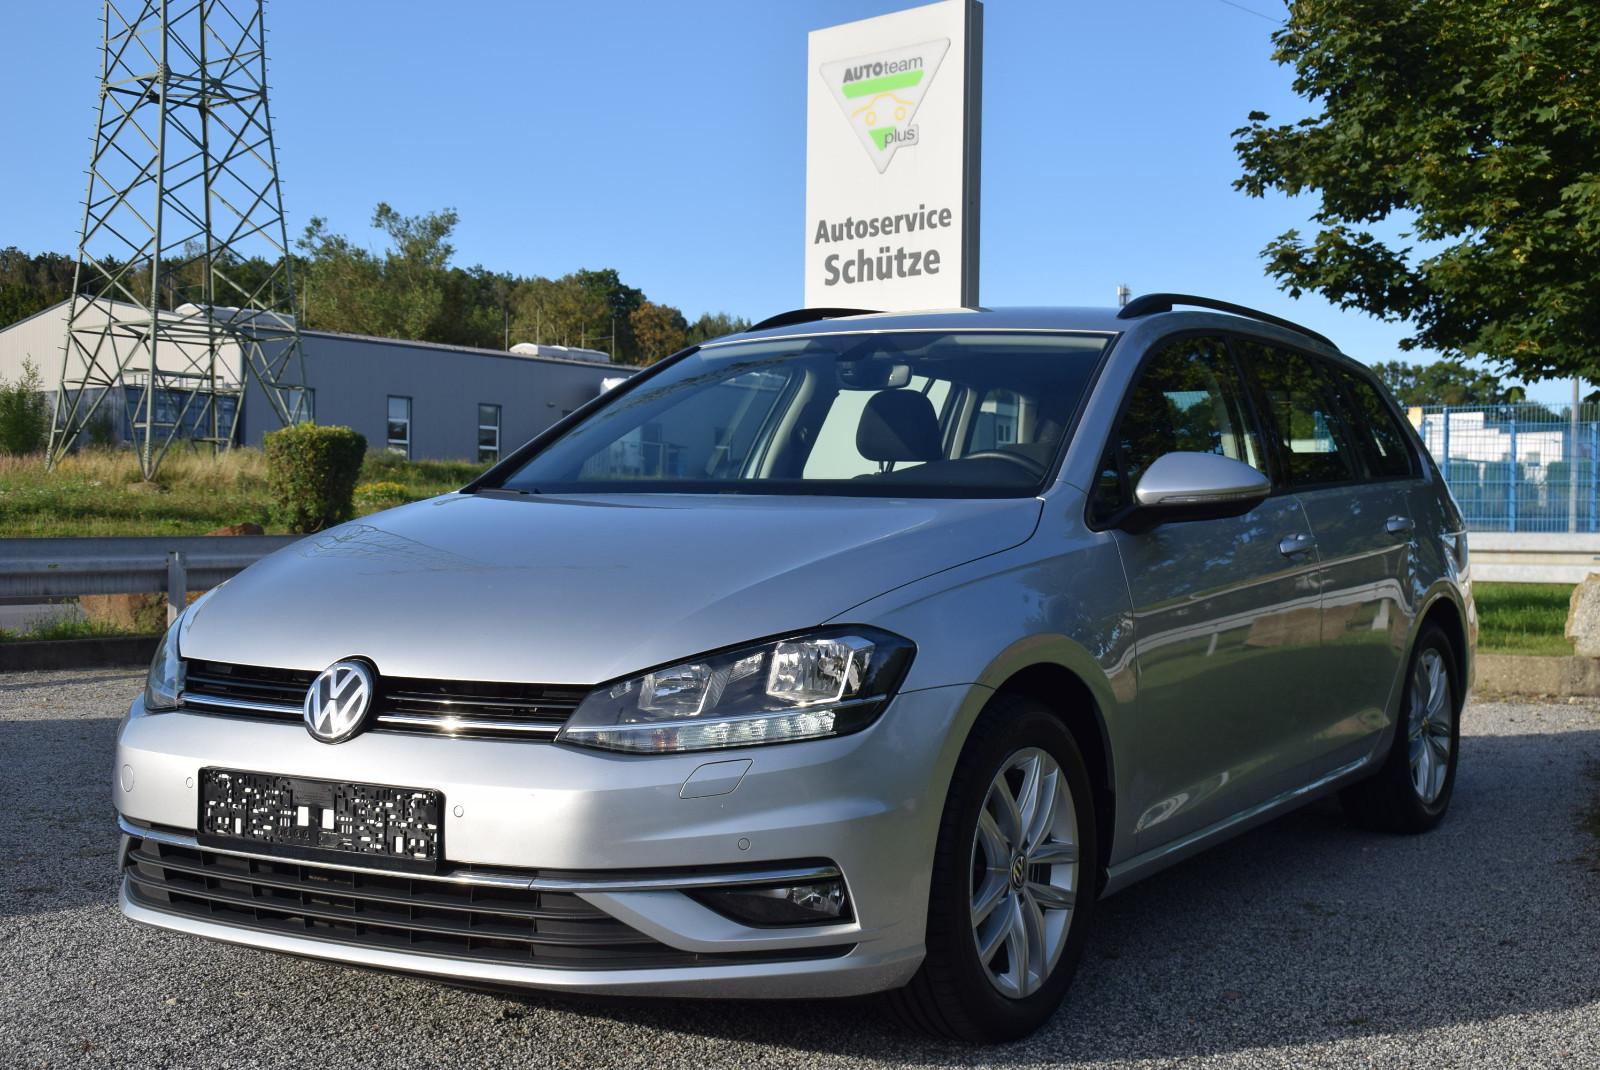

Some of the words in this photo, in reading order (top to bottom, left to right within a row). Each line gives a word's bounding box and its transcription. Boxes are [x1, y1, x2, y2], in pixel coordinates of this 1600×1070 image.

[843, 56, 923, 83] AUTOteam
[884, 127, 915, 148] plus
[814, 204, 952, 244] Autoservice
[824, 246, 941, 286] Schütze
[305, 662, 369, 739] VW
